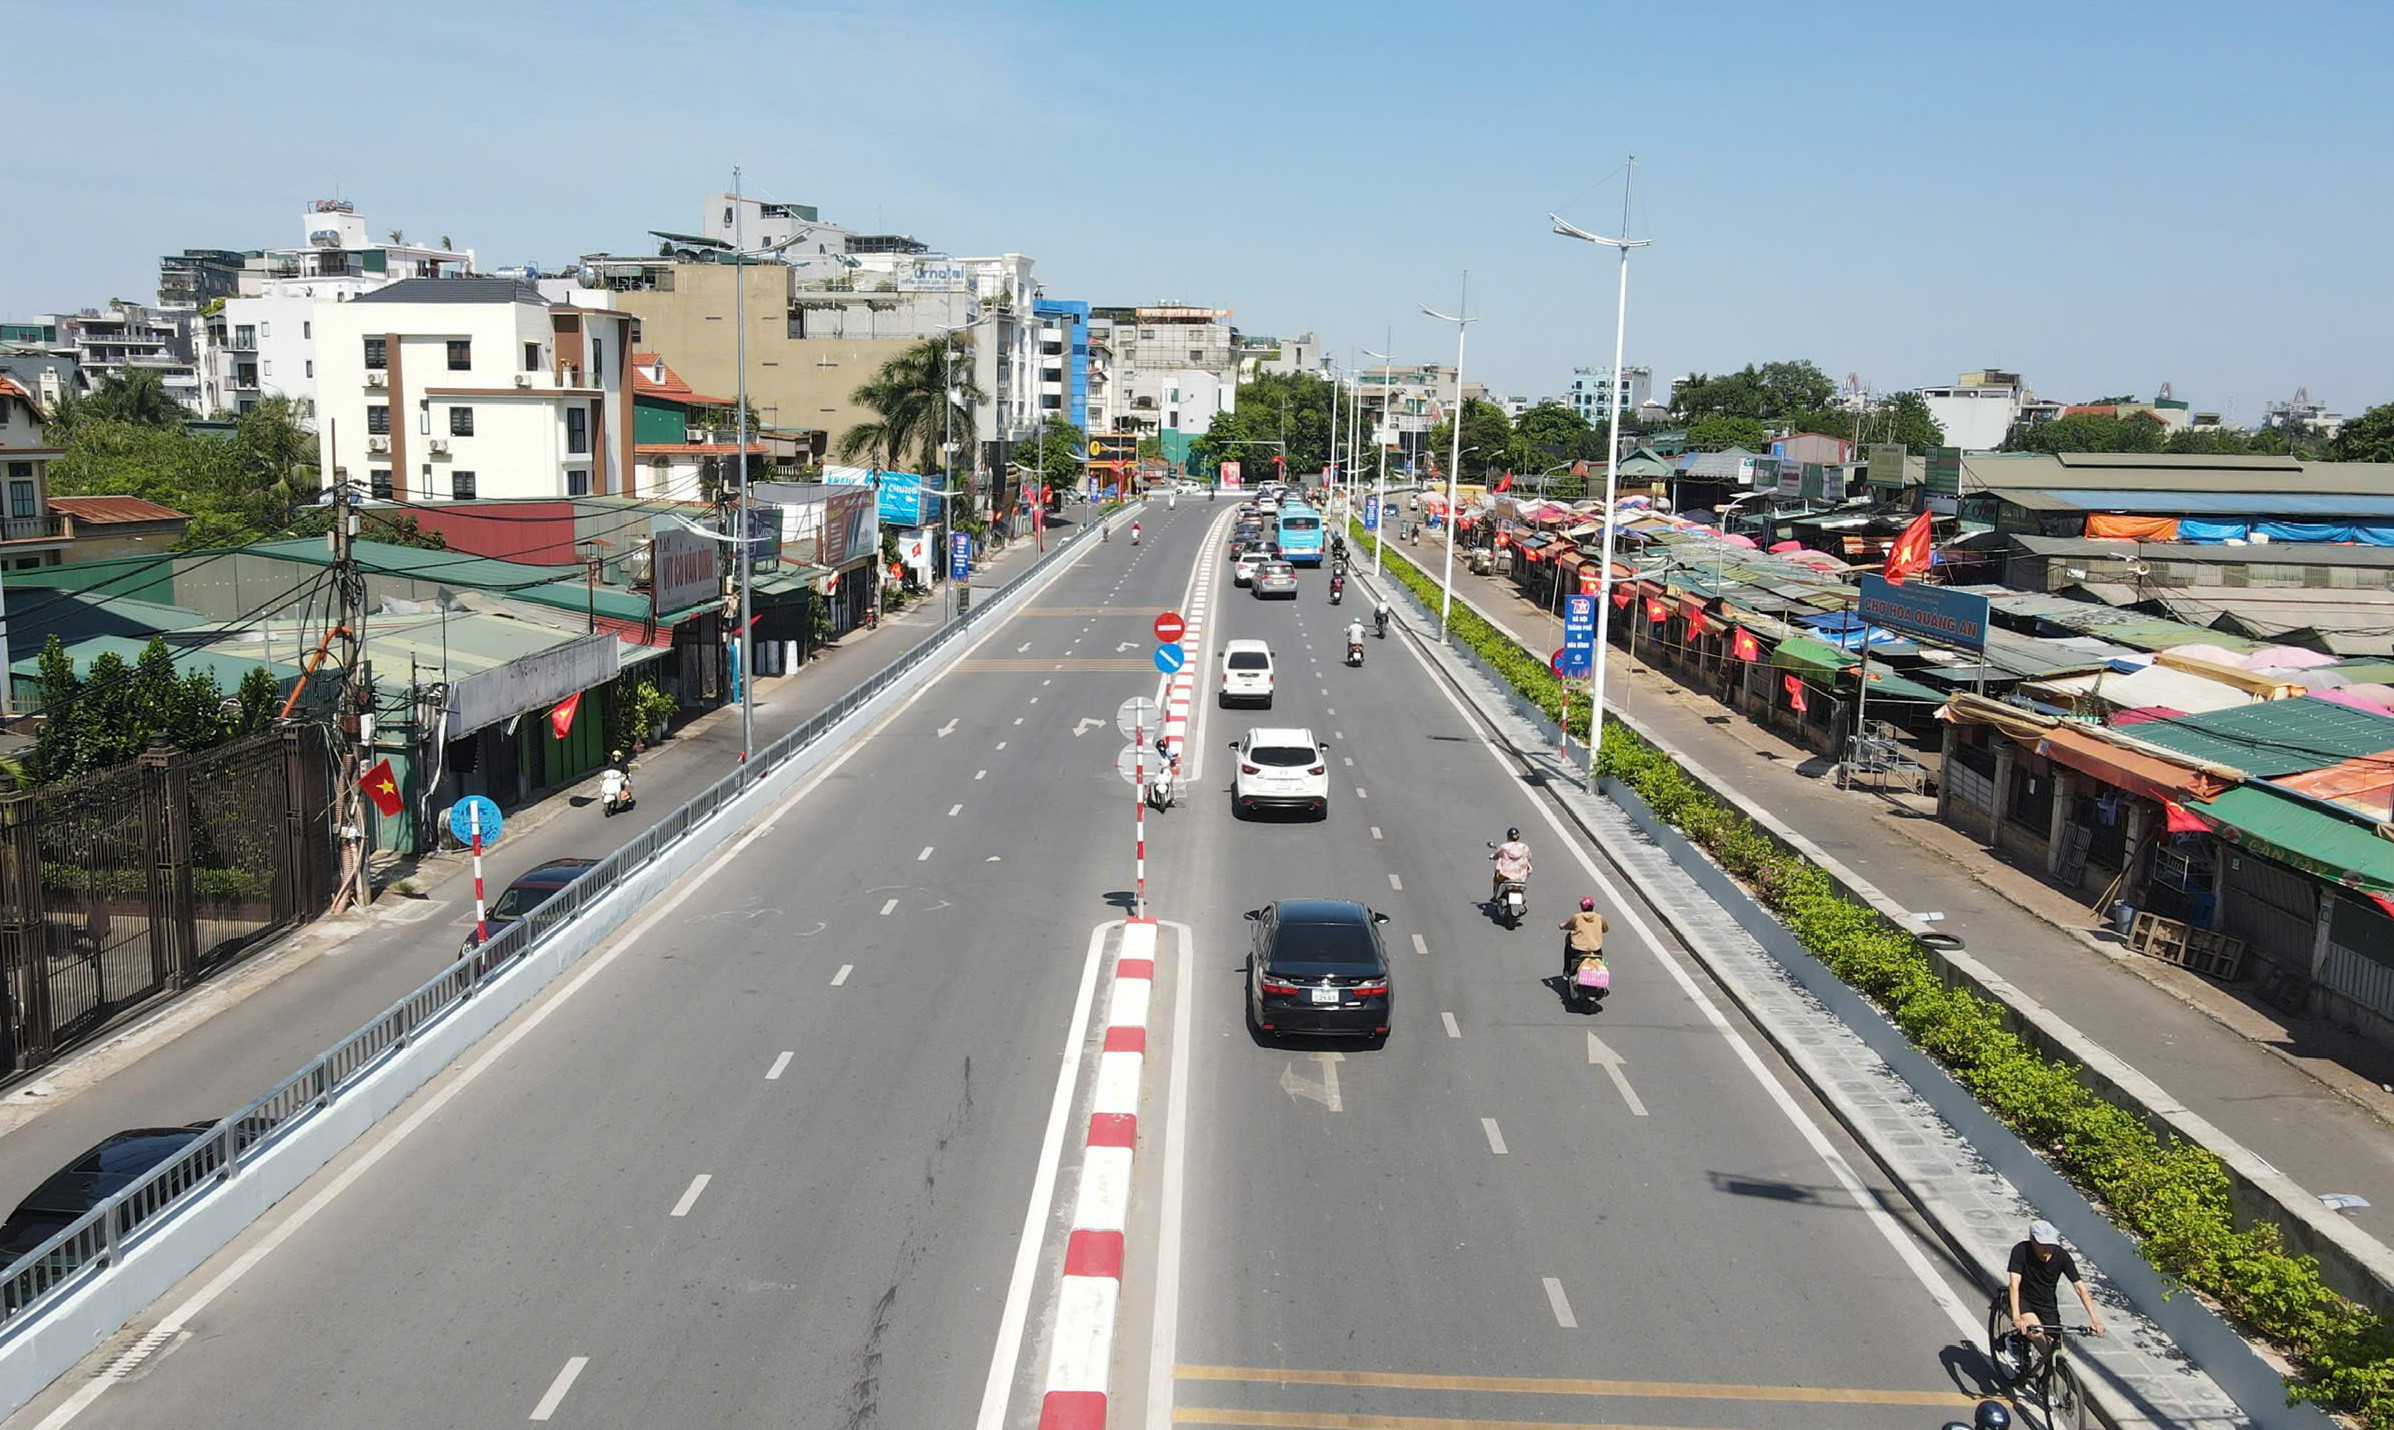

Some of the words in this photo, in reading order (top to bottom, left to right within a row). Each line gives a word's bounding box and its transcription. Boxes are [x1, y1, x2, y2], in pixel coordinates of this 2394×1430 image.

[1865, 598, 1887, 618] CHỢ
[1889, 602, 1912, 622] HOA
[1914, 607, 1956, 632] QUẢNG
[1959, 621, 1979, 638] AN
